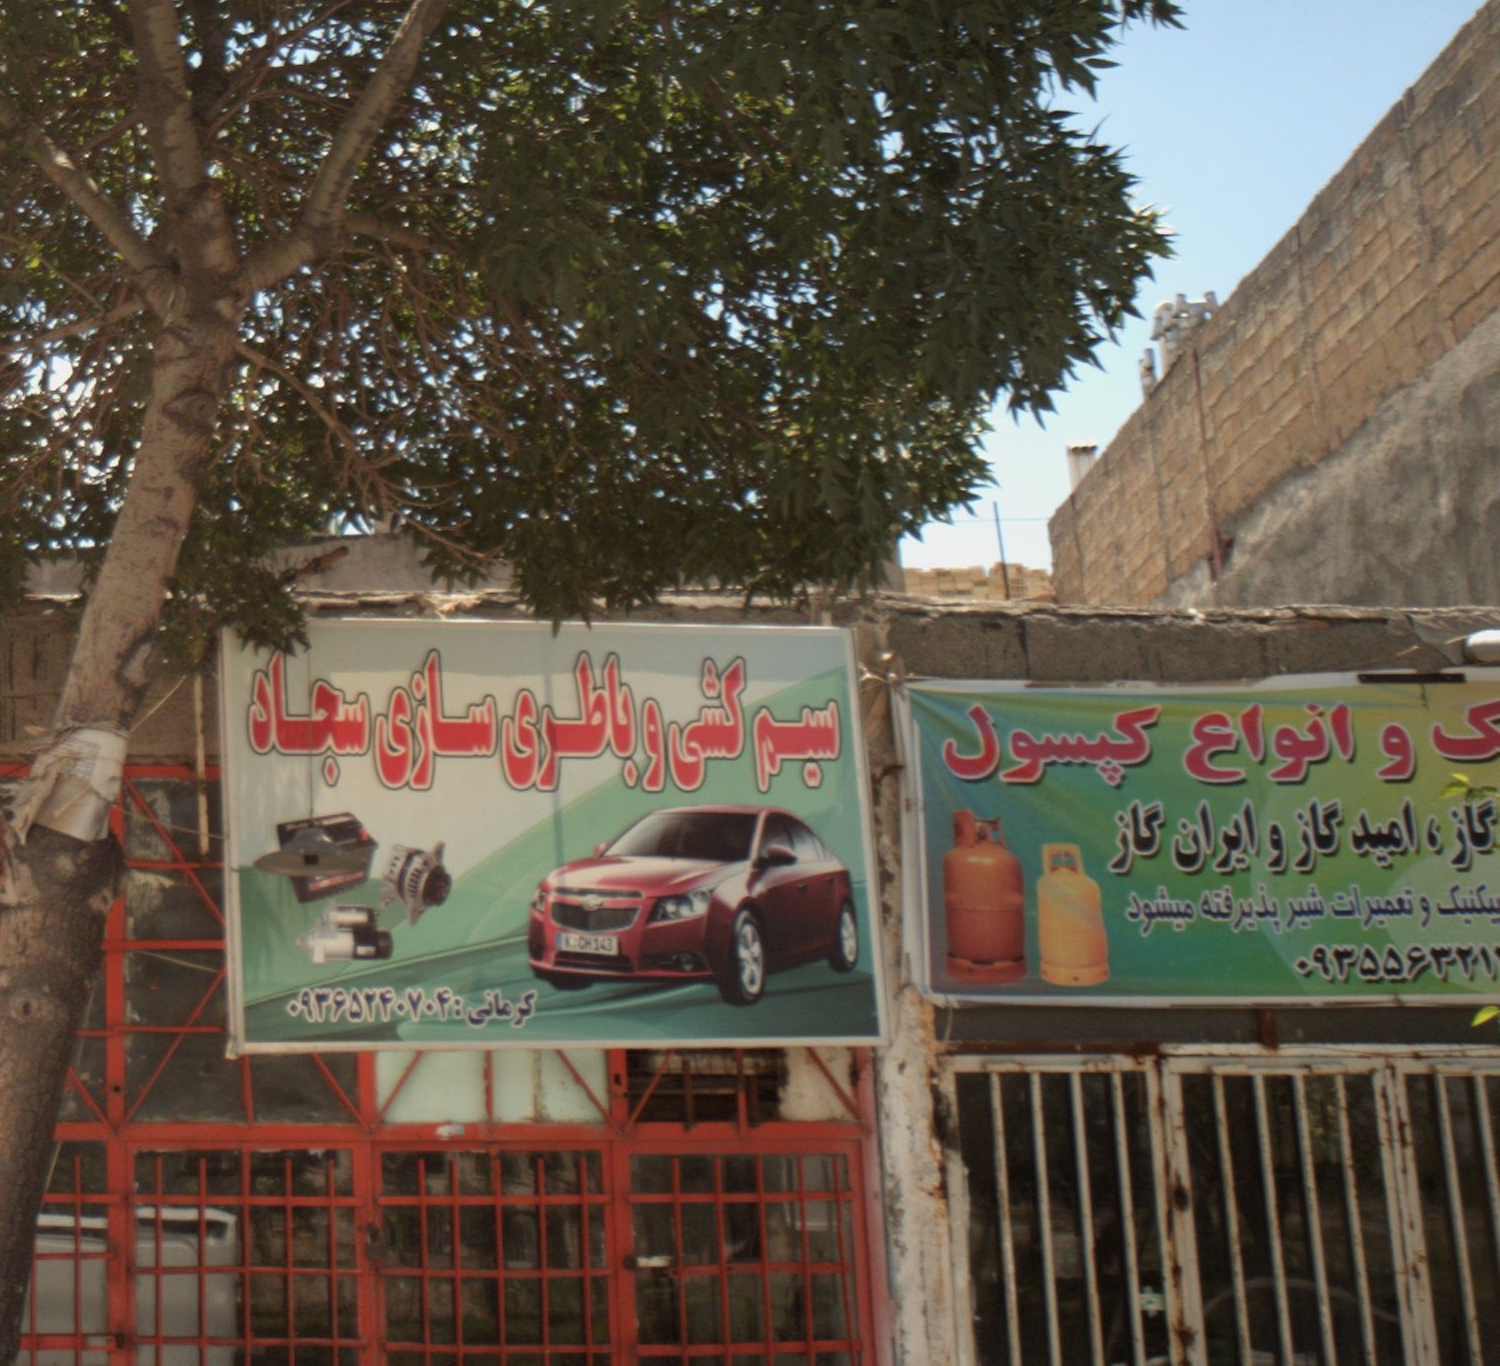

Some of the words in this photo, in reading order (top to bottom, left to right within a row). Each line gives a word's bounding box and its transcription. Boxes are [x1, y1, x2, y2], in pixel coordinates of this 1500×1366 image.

[248, 649, 371, 787] سجاد
[375, 648, 497, 791] سازی
[501, 651, 638, 792] باطری
[642, 697, 667, 793] و
[669, 656, 747, 792] کشی
[753, 699, 841, 793] سیم
[942, 702, 1162, 787] کپسول
[1183, 702, 1355, 783] انواع
[1377, 722, 1415, 781] و
[1108, 799, 1164, 873] گاز
[1172, 799, 1259, 872] ایران
[1266, 821, 1287, 872] و
[1293, 797, 1342, 871] گاز
[1352, 796, 1418, 868] امید
[1449, 798, 1497, 870] گاز
[1126, 885, 1196, 937] میشود
[1200, 883, 1283, 934] پذیرفته
[1285, 883, 1325, 932] شیر
[1331, 884, 1414, 930] تعمیرات
[1418, 895, 1431, 929] و
[1295, 944, 1500, 982] ۰۹۳۵۵۶۳۲۱
